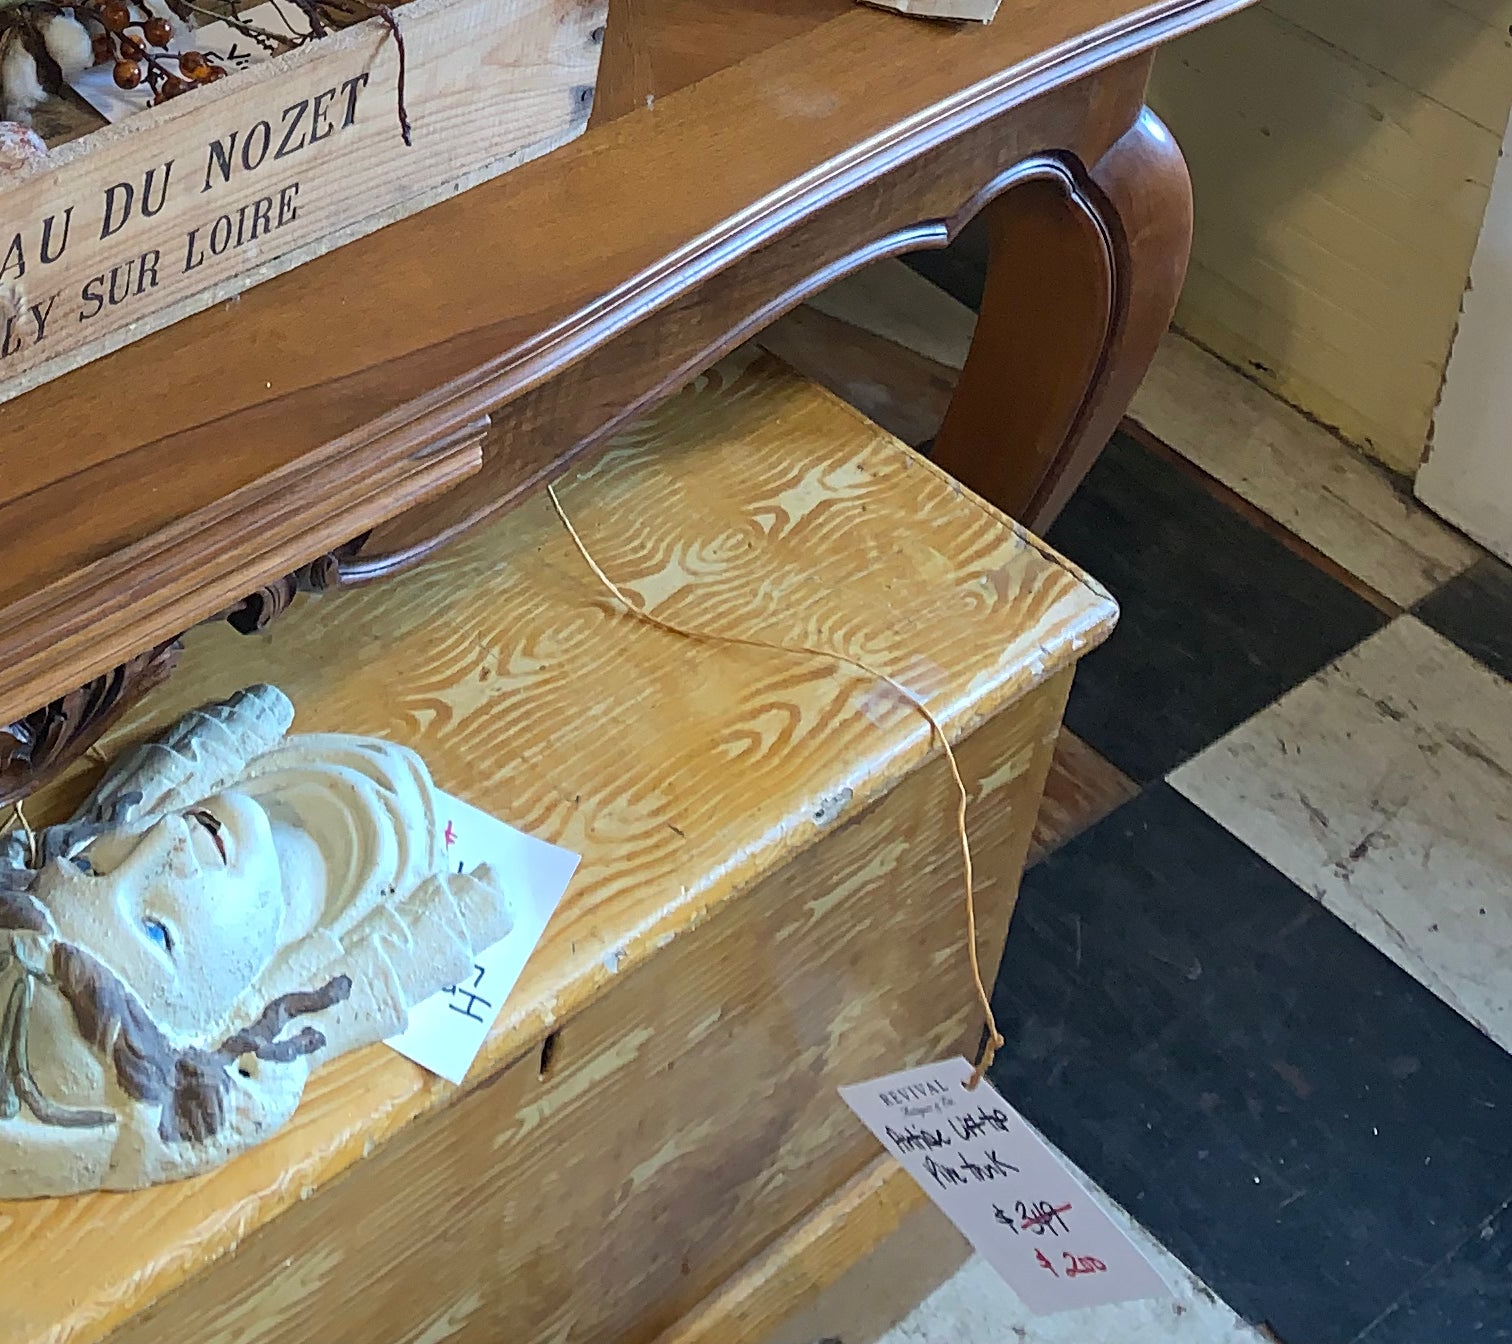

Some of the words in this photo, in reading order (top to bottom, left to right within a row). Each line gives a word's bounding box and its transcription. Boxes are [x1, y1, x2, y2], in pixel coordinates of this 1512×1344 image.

[100, 160, 175, 241] DU
[201, 73, 369, 193] NOZET
[78, 250, 163, 323] SUR
[183, 182, 300, 274] LOIRE
[879, 1078, 949, 1106] REVIVAL
